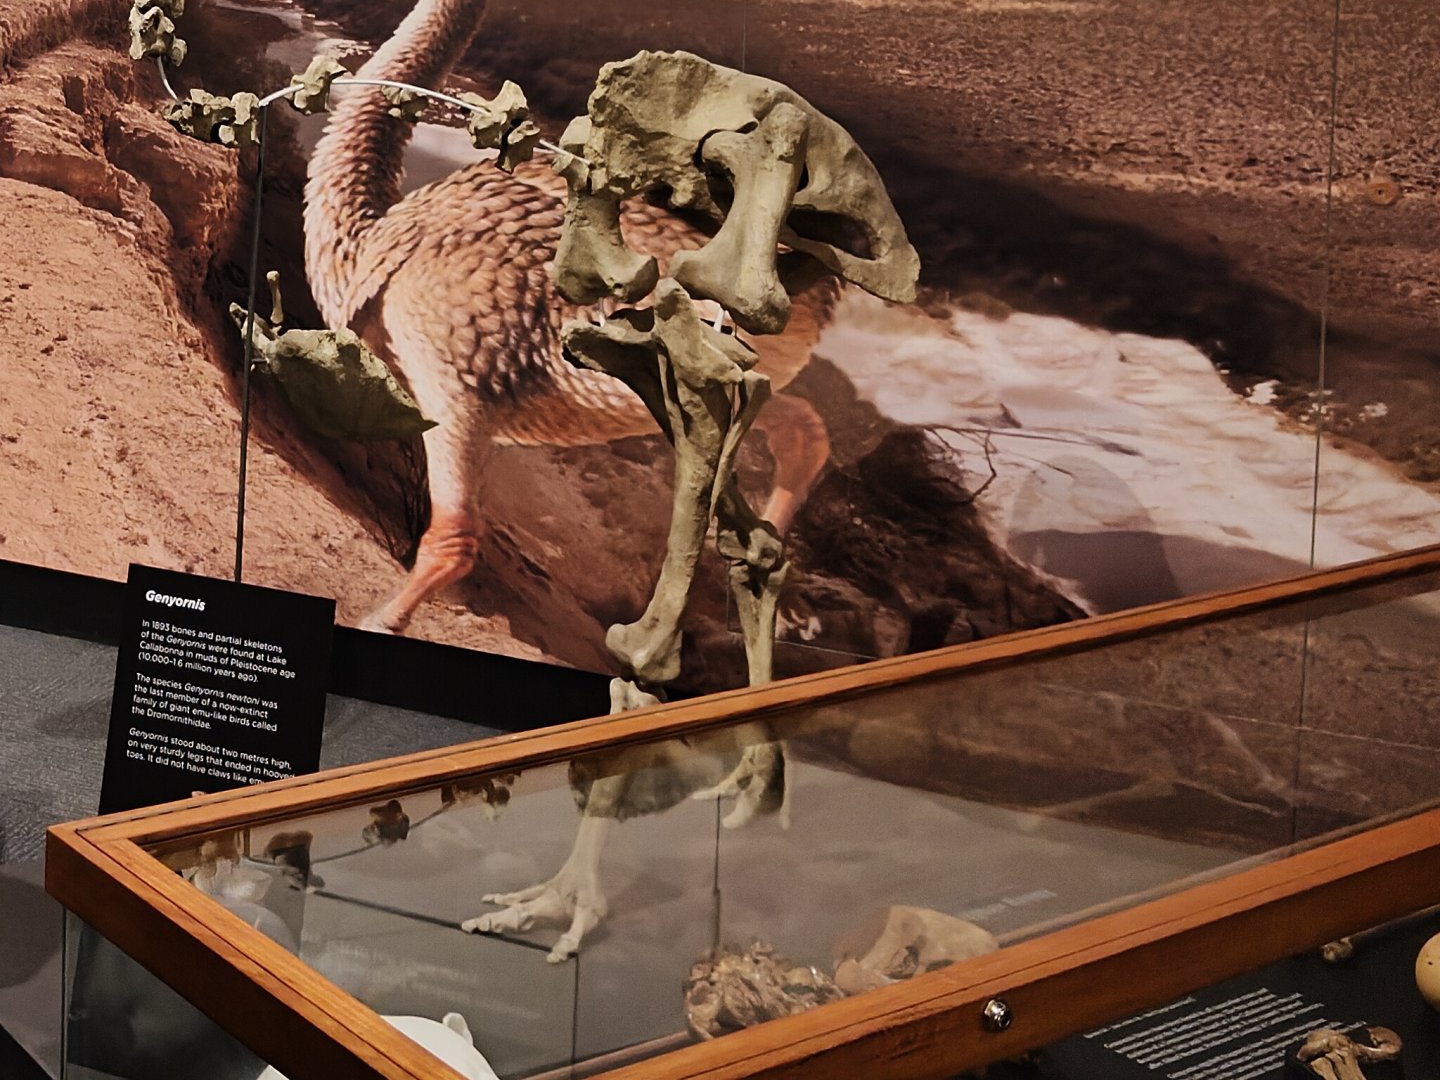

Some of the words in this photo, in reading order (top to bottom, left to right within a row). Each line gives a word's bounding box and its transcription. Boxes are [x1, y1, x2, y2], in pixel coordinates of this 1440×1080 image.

[145, 590, 206, 611] Genyornis
[140, 630, 150, 638] of
[151, 632, 165, 642] the
[166, 635, 206, 650] Genyornis
[208, 645, 228, 654] were
[230, 647, 255, 659] found
[256, 653, 264, 661] at
[266, 654, 287, 665] Lake
[142, 619, 150, 627] In
[152, 620, 170, 632] 1893
[171, 625, 196, 637] bones
[198, 631, 214, 640] and
[215, 634, 242, 645] partial
[244, 639, 282, 653] skeletons
[185, 662, 212, 673] million
[214, 668, 236, 678] years
[195, 653, 218, 663] muds
[219, 657, 229, 665] of
[230, 658, 278, 675] Pleistocene
[279, 669, 296, 679] age
[134, 684, 148, 694] the
[149, 687, 164, 697] last
[165, 691, 200, 704] member
[201, 698, 211, 706] of
[219, 702, 268, 719] now-extinct
[136, 672, 151, 683] The
[152, 678, 182, 690] species
[184, 682, 224, 698] Genyornis
[226, 693, 260, 705] newtoni
[261, 700, 278, 709] was
[132, 706, 145, 715] the
[133, 694, 157, 708] family
[159, 701, 168, 709] of
[169, 703, 190, 714] giant
[192, 708, 227, 721] emu-like
[229, 714, 250, 726] birds
[251, 721, 277, 732] called
[127, 739, 138, 747] on
[140, 743, 158, 753] very
[159, 746, 185, 759] sturdy
[187, 751, 204, 763] legs
[206, 756, 223, 766] that
[224, 760, 252, 772] ended
[129, 727, 168, 743] Genyornis
[171, 737, 194, 748] stood
[195, 743, 220, 754] about
[222, 747, 238, 758] two
[240, 752, 269, 765] metres
[126, 749, 145, 760] toes.
[147, 754, 153, 763] It
[155, 756, 169, 766] did
[170, 760, 184, 769] not
[186, 762, 206, 774] have
[207, 768, 231, 780] claws
[233, 772, 247, 783] like
